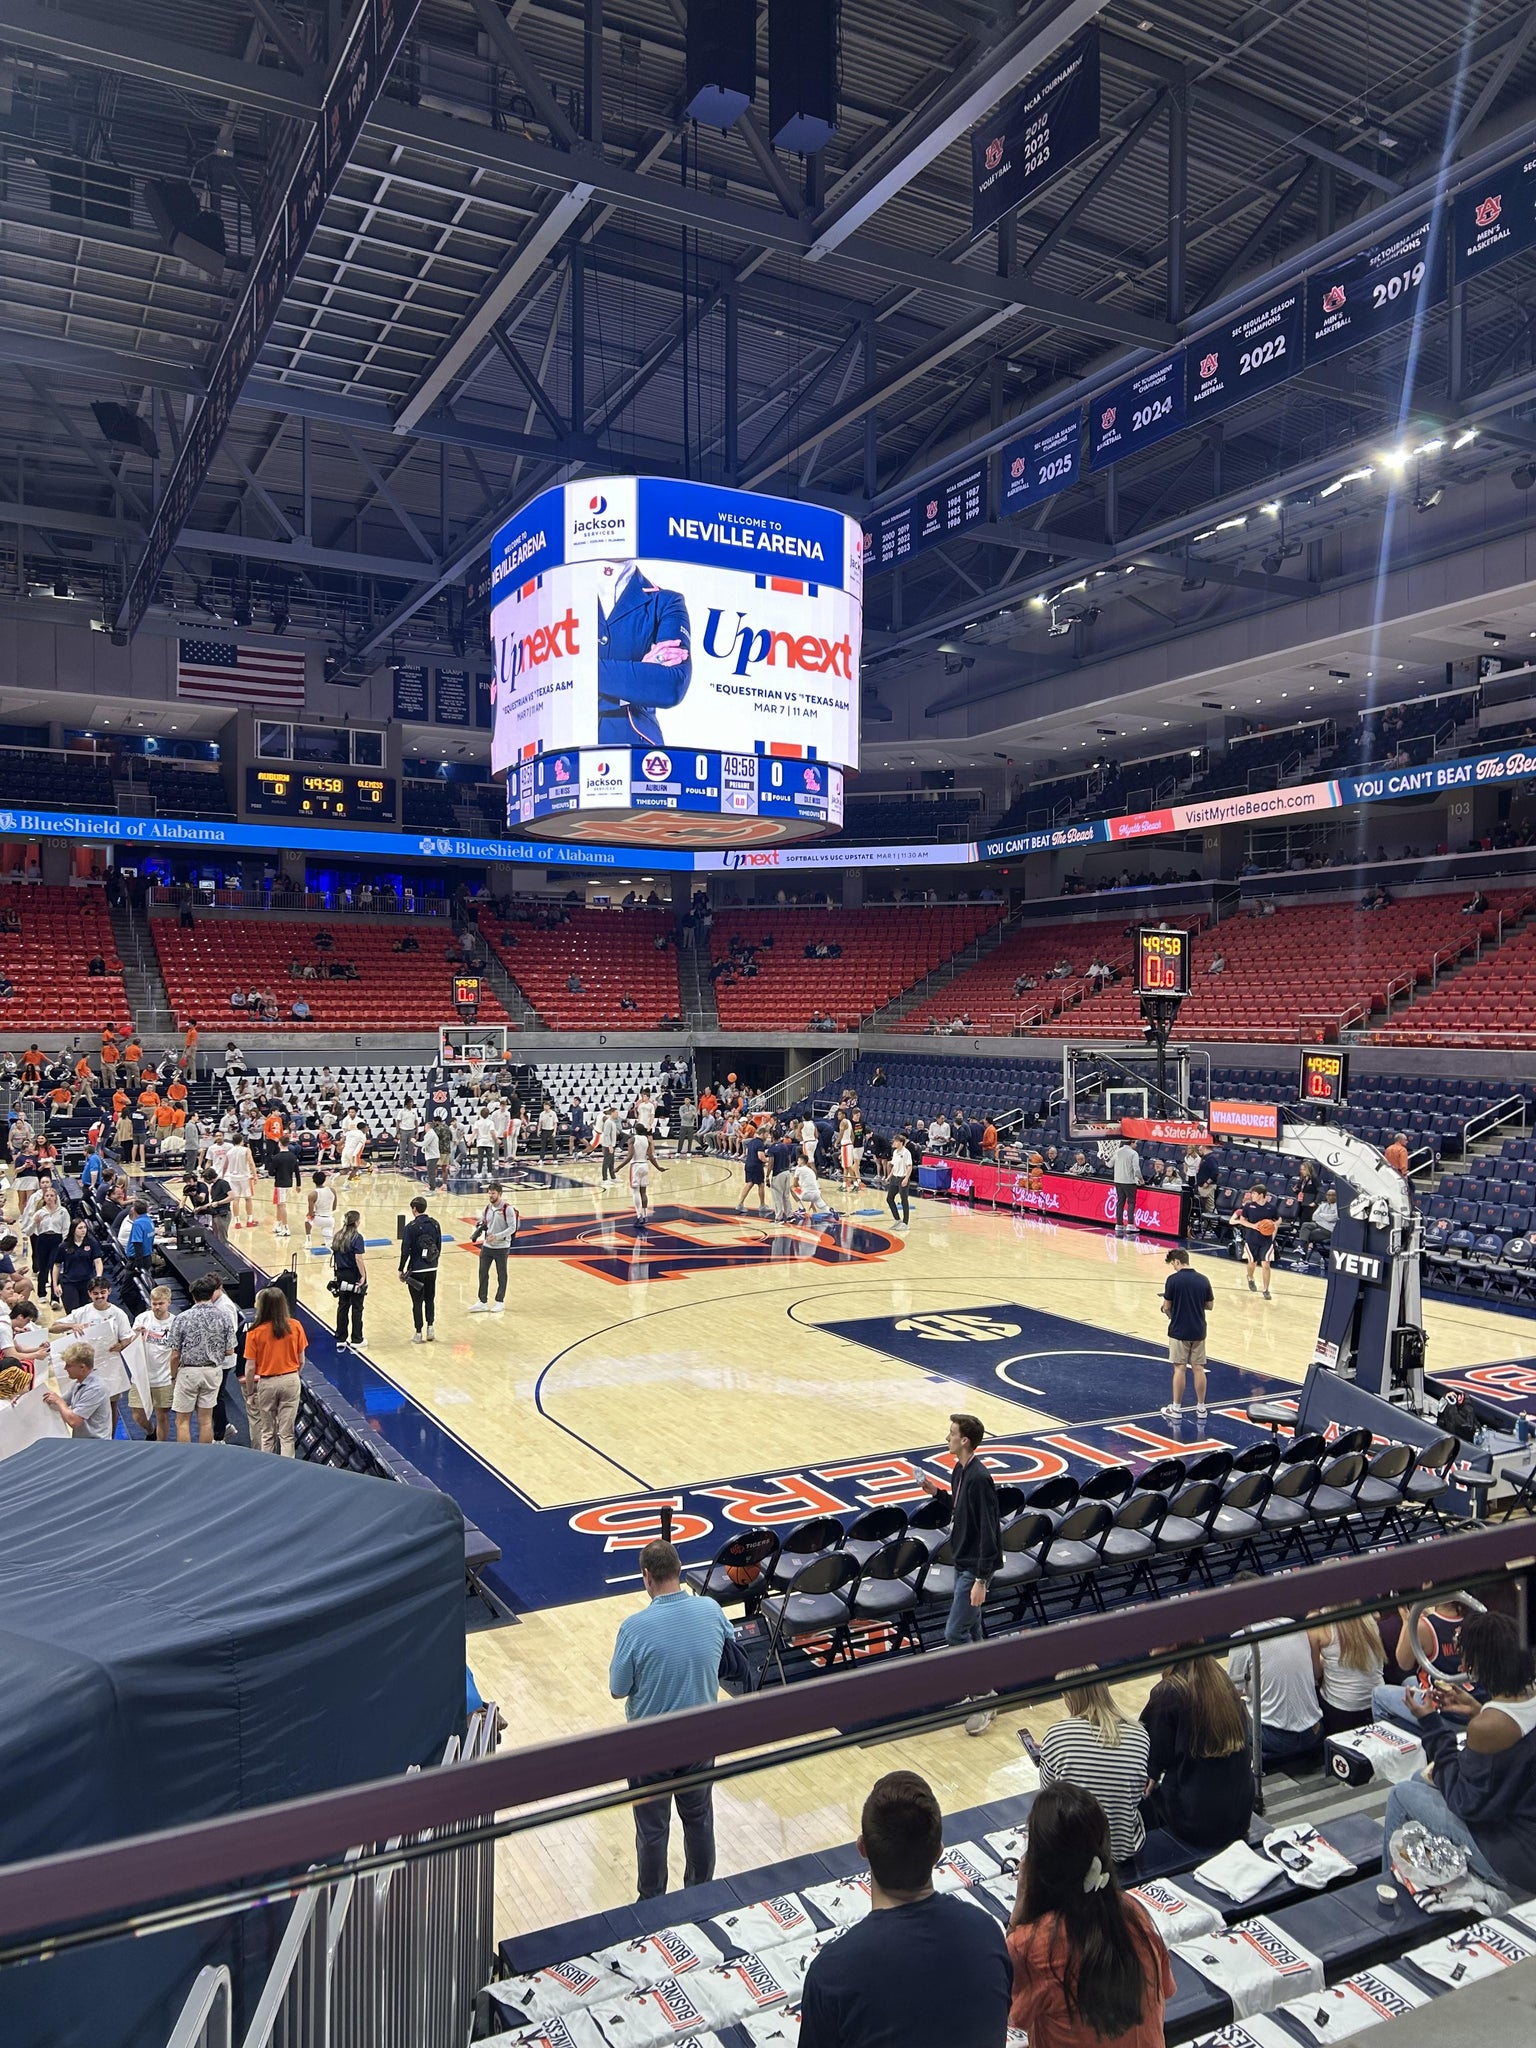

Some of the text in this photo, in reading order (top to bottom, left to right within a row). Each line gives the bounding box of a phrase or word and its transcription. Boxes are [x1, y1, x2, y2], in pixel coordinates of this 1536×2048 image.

[1024, 54, 1084, 113] NCAA TOURNAMENT
[1025, 113, 1049, 141] 2010
[1024, 130, 1050, 160] 2022
[1024, 146, 1050, 176] 2023
[979, 161, 1012, 192] VOLLEYBALL
[1467, 228, 1511, 256] BASKETBALL
[1477, 224, 1501, 242] MEN'S
[1369, 222, 1430, 266] SEC TOURNAMENT
[1373, 261, 1426, 309] 2019
[1232, 297, 1296, 338] SEC REGULAR SEASON
[1244, 314, 1281, 339] CHAMPIONS
[1323, 312, 1343, 326] MEN'S
[1315, 317, 1351, 339] BASKETBALL
[1239, 335, 1286, 376] 2022
[1132, 363, 1173, 390] SEC TOURNAMENT
[1138, 374, 1167, 394] CHAMPIONS
[1201, 377, 1217, 390] MEN'S
[1194, 382, 1225, 402] BASKETBALL
[1132, 396, 1173, 432] 2024
[1096, 433, 1122, 452] BASKETBALL
[1038, 453, 1072, 485] 2025
[965, 486, 980, 499] 1987
[1007, 481, 1030, 498] BASKETBALL
[718, 512, 782, 531] WELCOME TO
[965, 507, 979, 521] 1999
[573, 518, 625, 535] jackson
[503, 531, 528, 555] WELCOME TO
[668, 517, 825, 561] NEVILLE ARENA
[491, 530, 547, 588] NEVILLE ARENA
[500, 608, 580, 693] Upnext
[703, 608, 853, 680] Upnext
[527, 691, 534, 702] VS
[536, 683, 555, 697] TEXAS
[555, 680, 574, 692] A&M
[716, 684, 850, 711] EQUESTRIAN VS TEXAS A&M
[536, 702, 544, 713] AM
[754, 703, 818, 718] MAR 7 11 AM
[695, 755, 708, 780] 0
[724, 756, 755, 777] 49:58
[772, 762, 783, 786] 0
[258, 772, 290, 782] AUBURN
[305, 778, 342, 792] 49:58
[586, 778, 622, 788] jackson
[1354, 781, 1384, 799] YOU
[1388, 771, 1433, 793] CAN'T
[1437, 764, 1472, 786] BEAT
[1475, 757, 1507, 781] The
[274, 783, 284, 795] 0
[371, 790, 380, 802] 0
[686, 787, 705, 795] FOULS
[773, 794, 791, 802] FOULS
[302, 800, 344, 812] 0 0
[735, 797, 745, 806] 0.0
[1186, 792, 1315, 824] VisitMyrtleBeach.com
[1450, 802, 1470, 816] 103
[799, 810, 820, 818] TIMEOUTS
[20, 815, 120, 835] BlueShield
[127, 822, 146, 836] of
[151, 824, 225, 841] Alabama
[1141, 820, 1162, 833] Beach
[987, 826, 1094, 855] YOU CAN'T BEAT The Beach
[1204, 838, 1218, 849] 104
[456, 841, 615, 863] BlueShield of Alabama
[844, 853, 874, 861] UPSTATE
[876, 852, 893, 860] MAR
[494, 862, 510, 872] 106
[846, 870, 861, 878] 105
[1143, 936, 1181, 955] 49:58
[455, 979, 478, 989] 49:58
[73, 1036, 80, 1048] F
[354, 1035, 361, 1047] E
[600, 1035, 607, 1045] D
[974, 1039, 980, 1051] C
[1308, 1057, 1340, 1076] 49:58
[1212, 1110, 1275, 1128] WHATABURGER
[1511, 1240, 1524, 1253] 3
[1333, 1250, 1380, 1279] YETI
[745, 1537, 771, 1550] TIGERS
